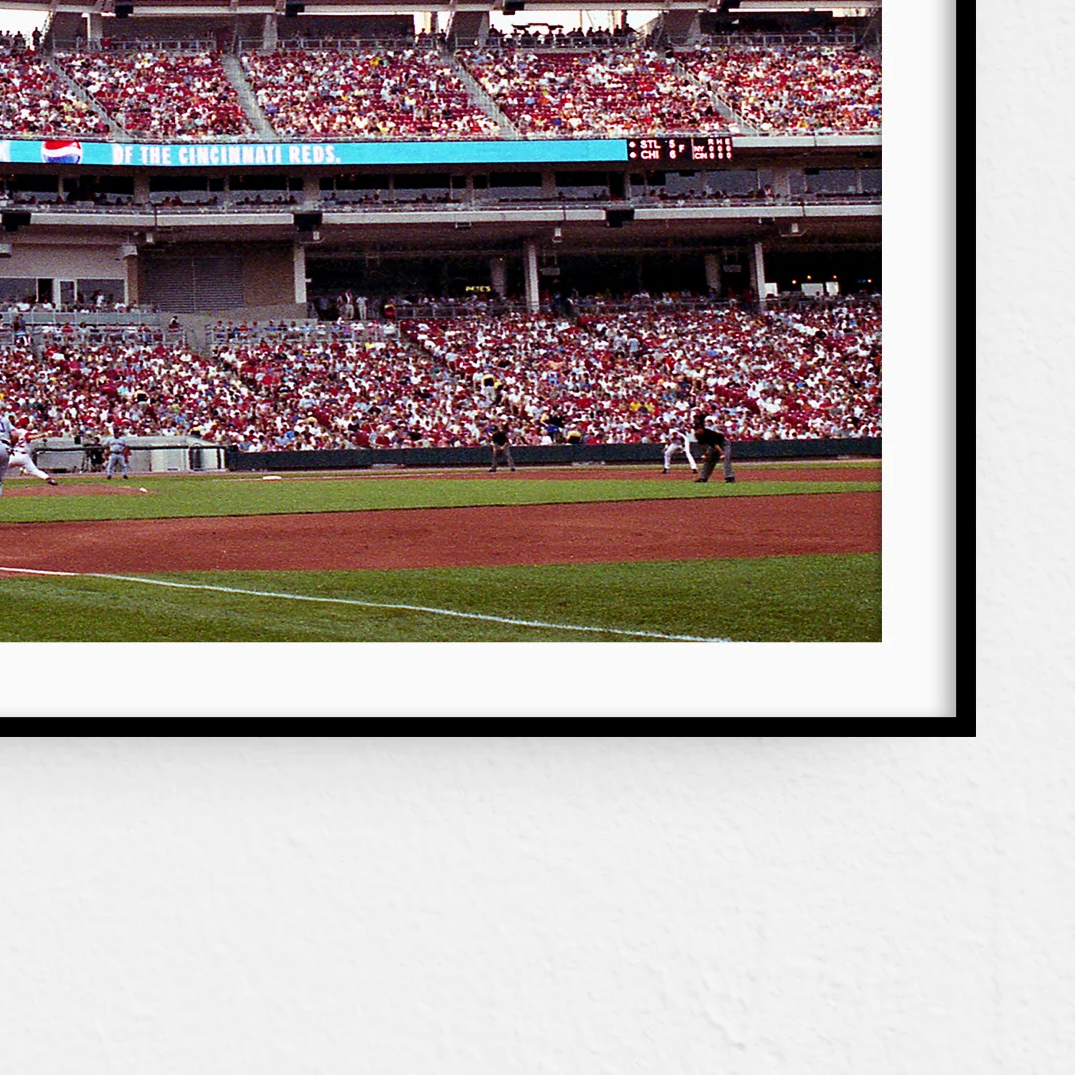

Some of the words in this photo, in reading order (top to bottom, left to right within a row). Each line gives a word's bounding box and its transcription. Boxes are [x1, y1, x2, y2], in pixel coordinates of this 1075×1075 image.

[640, 139, 661, 149] STL
[678, 144, 684, 152] F
[141, 144, 171, 165] THE
[179, 144, 282, 165] CINCINNATI
[289, 145, 341, 164] REDS.
[640, 150, 660, 159] CHI
[670, 150, 676, 159] 6
